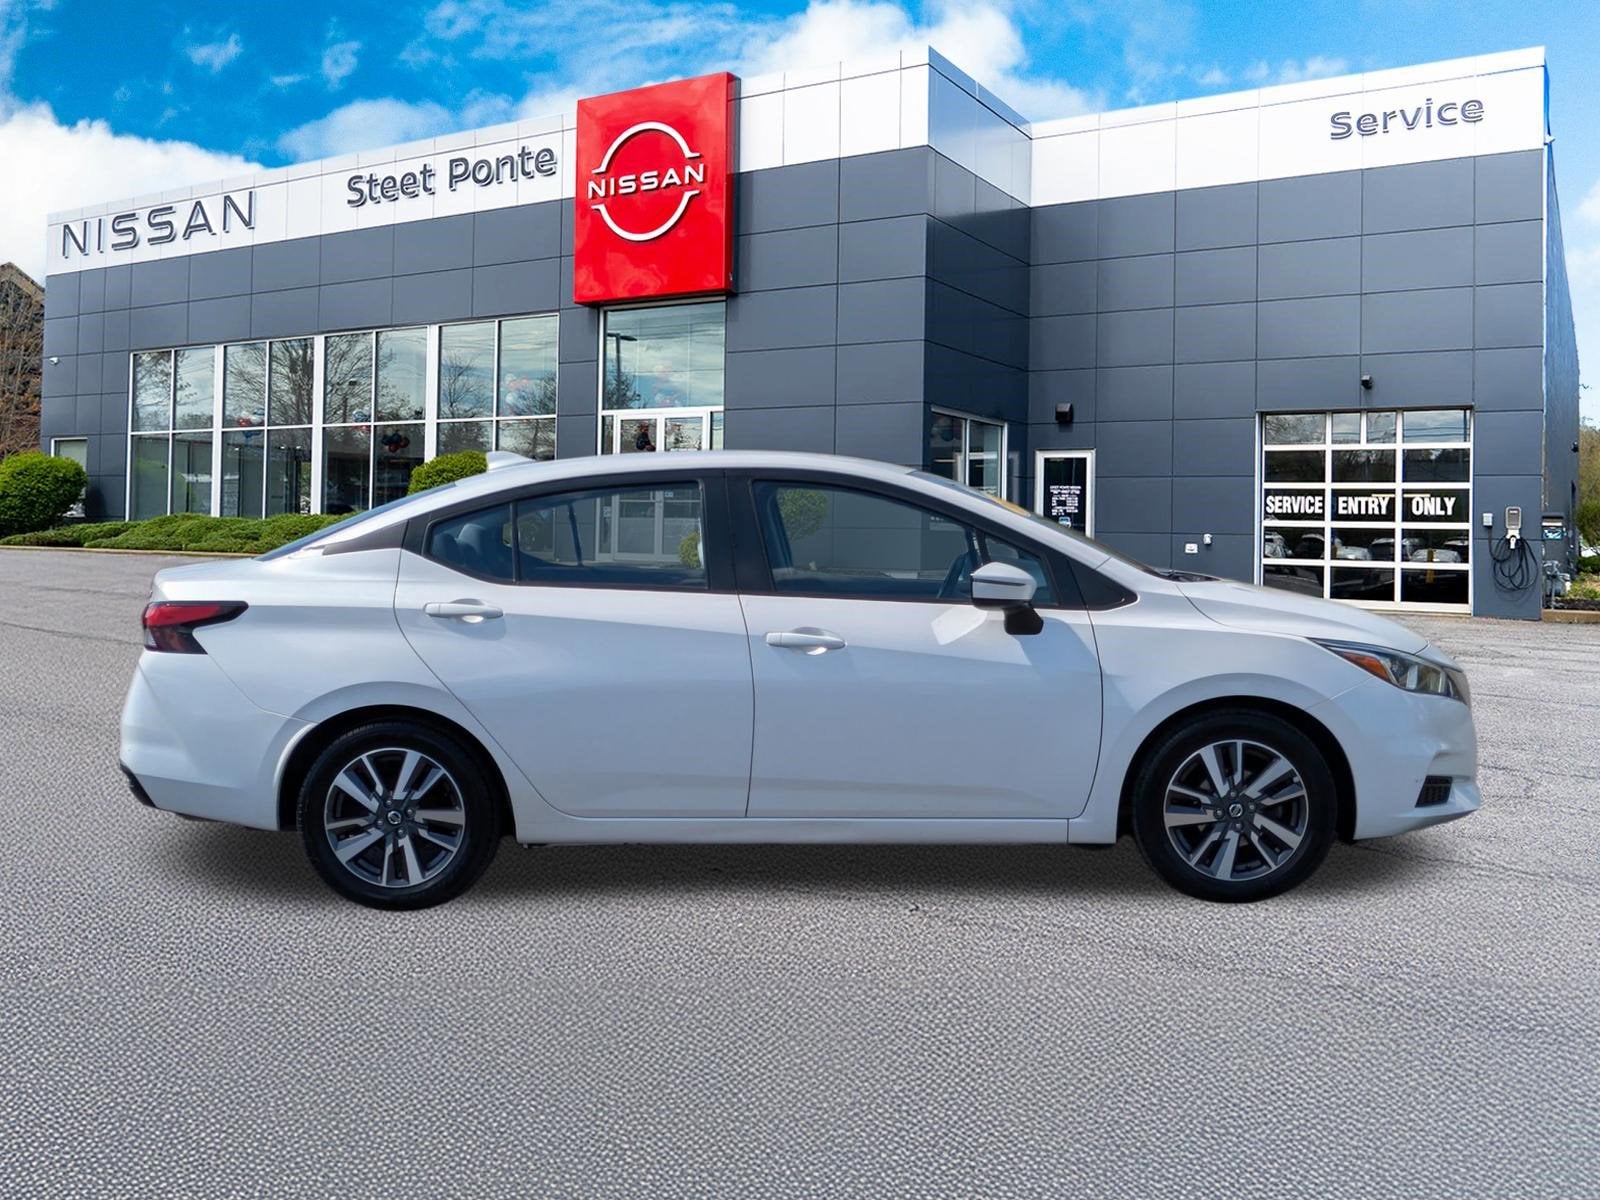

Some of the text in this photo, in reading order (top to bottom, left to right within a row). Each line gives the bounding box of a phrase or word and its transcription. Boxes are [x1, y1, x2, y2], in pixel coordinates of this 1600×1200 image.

[1330, 98, 1484, 140] Service
[347, 146, 557, 207] Steet Ponte
[587, 163, 705, 199] NISSAN
[62, 191, 255, 259] NISSAN
[1265, 495, 1456, 515] SERVICE ENTRY ONLY
